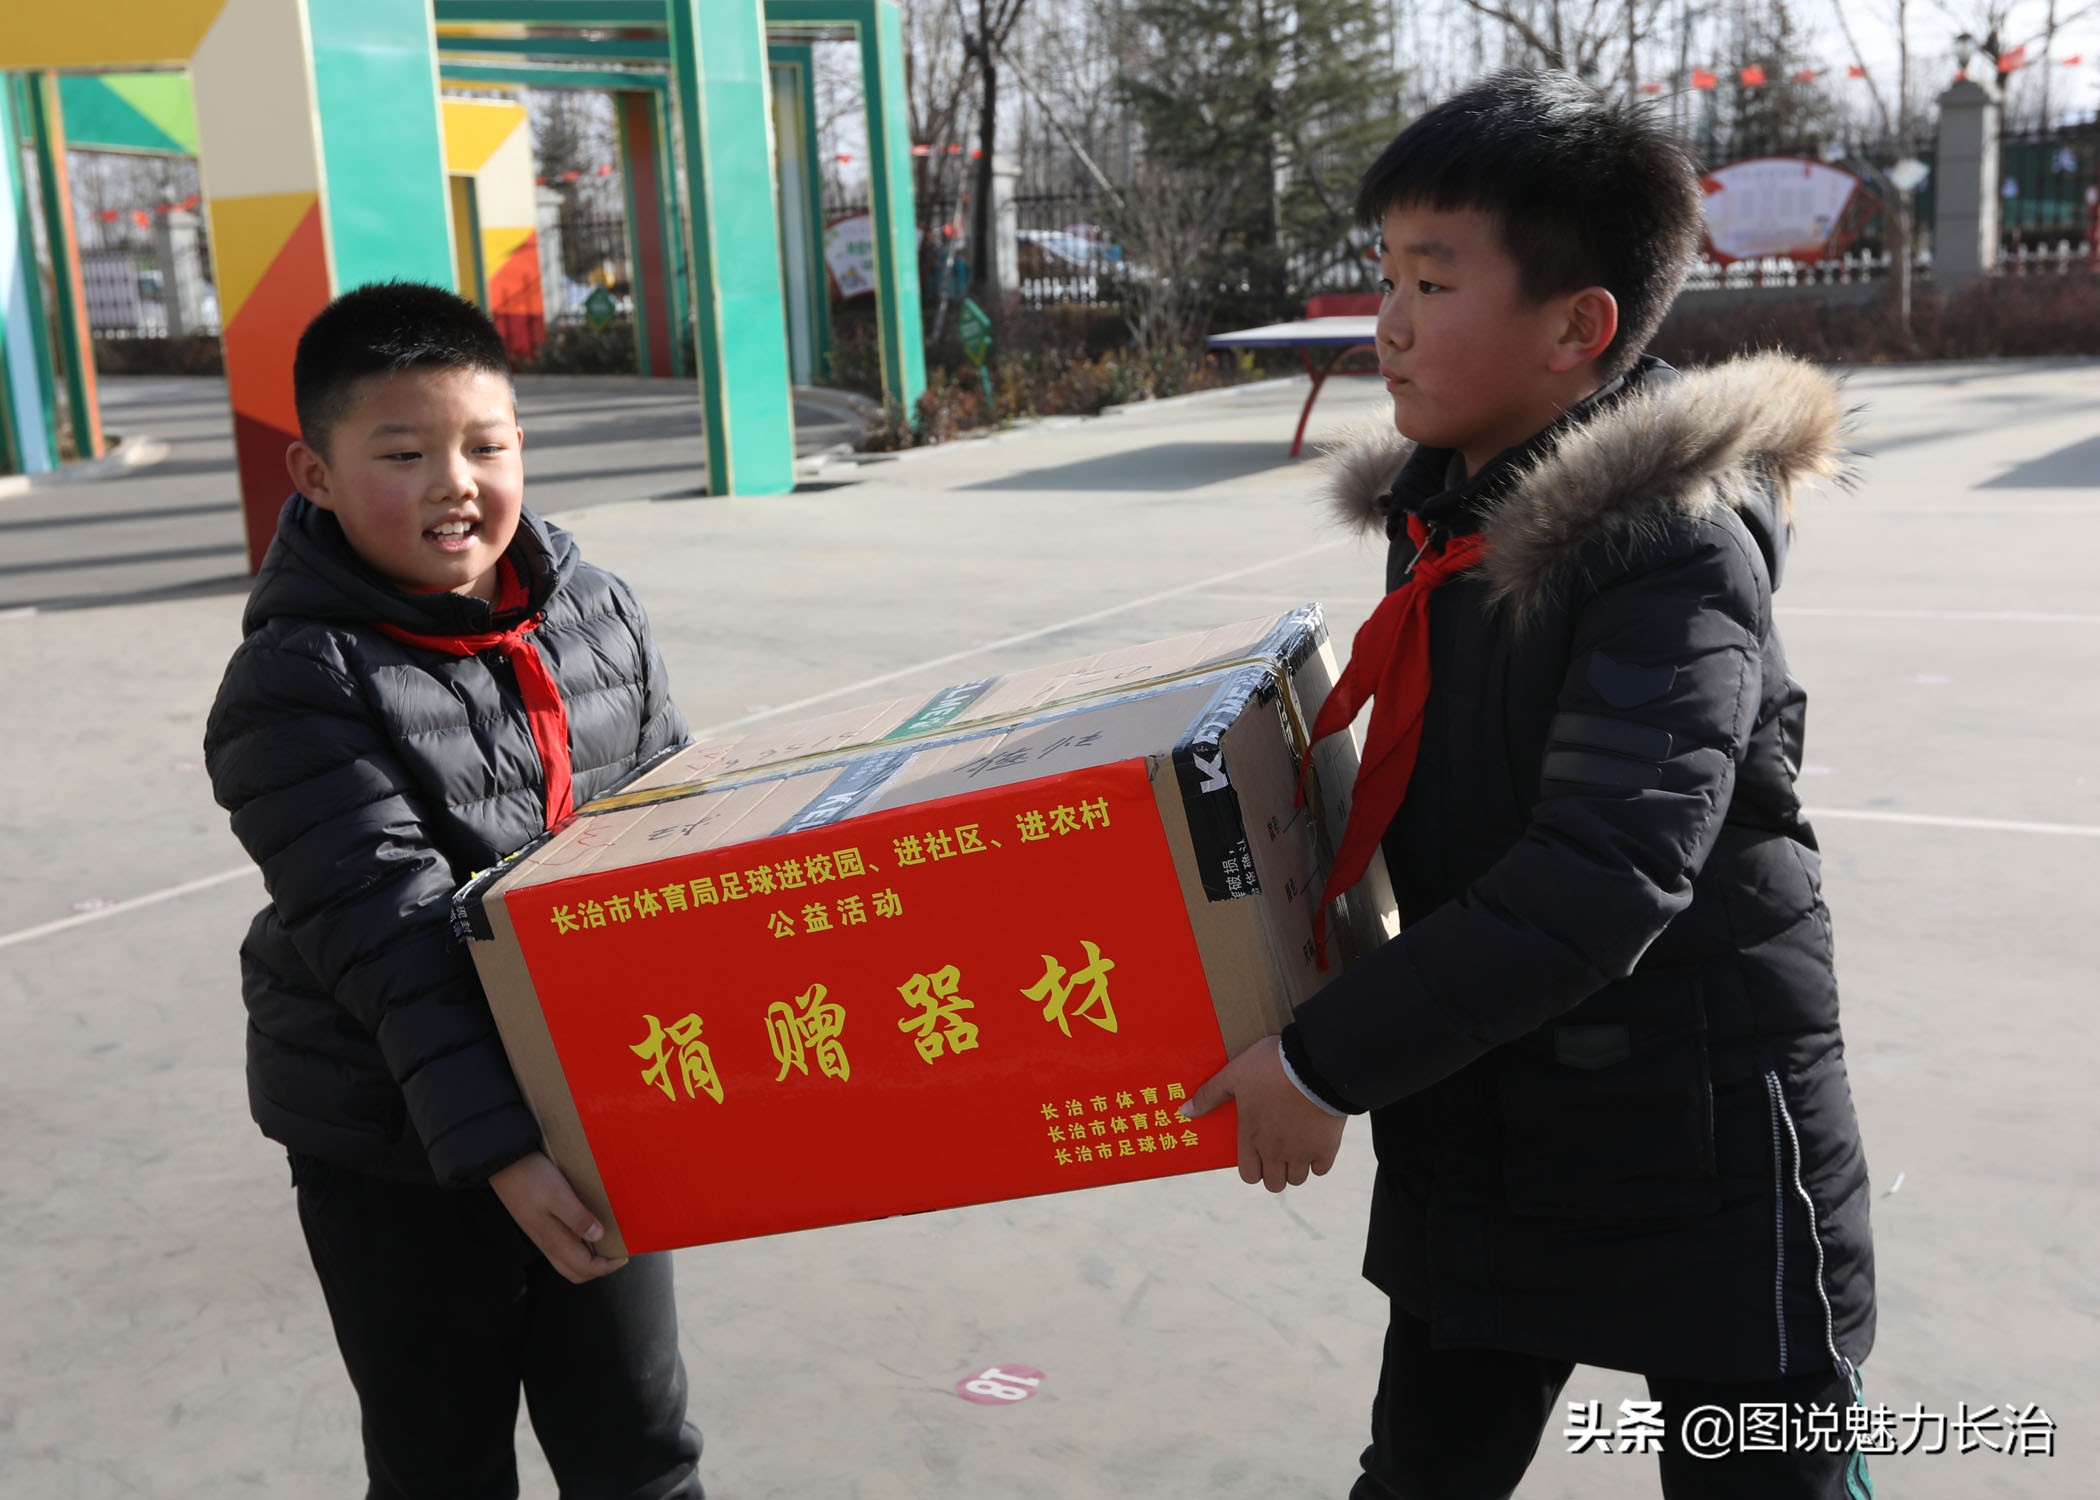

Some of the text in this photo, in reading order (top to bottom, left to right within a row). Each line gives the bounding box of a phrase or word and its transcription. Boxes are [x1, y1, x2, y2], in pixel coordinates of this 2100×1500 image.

[550, 797, 1111, 935] 长治市体育局足球进校园、进社区、进农村
[766, 888, 903, 939] 公益活动
[629, 940, 1119, 1106] 捐赠器材
[1040, 1082, 1187, 1121] 长治市体育局
[1047, 1107, 1193, 1144] 长治市体育总会
[1054, 1129, 1200, 1166] 长治市足球协会
[965, 1368, 1040, 1401] 18
